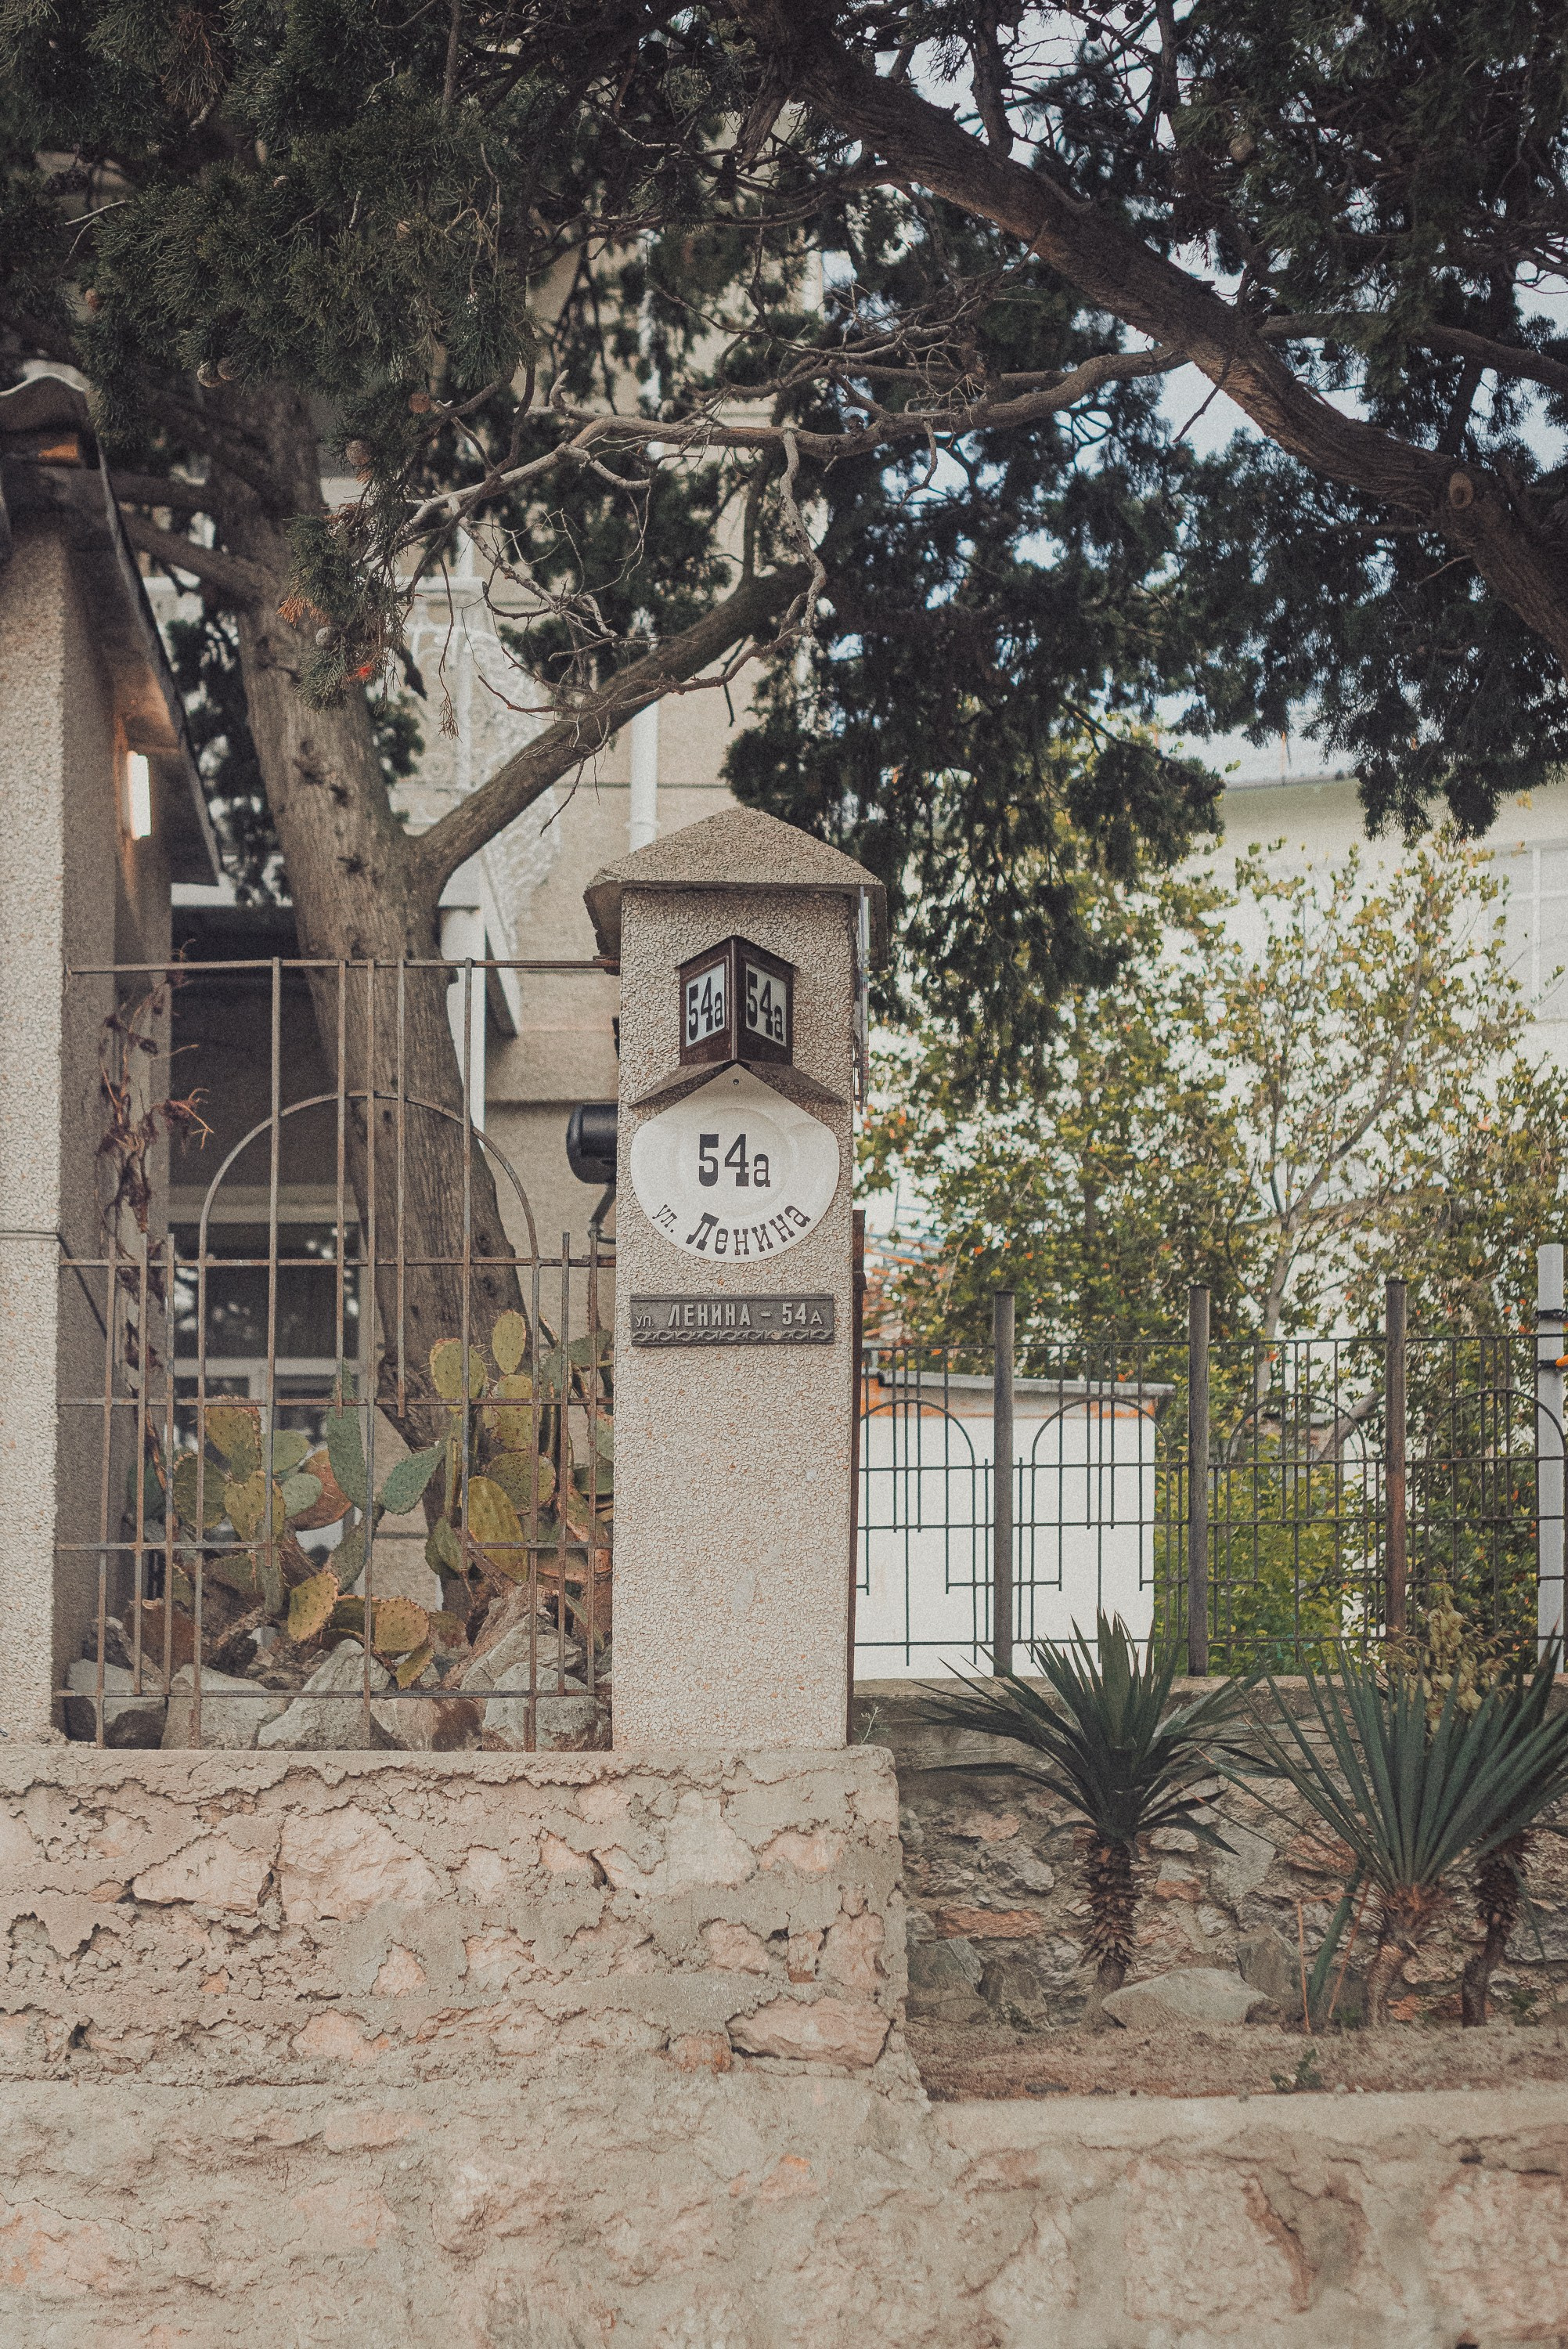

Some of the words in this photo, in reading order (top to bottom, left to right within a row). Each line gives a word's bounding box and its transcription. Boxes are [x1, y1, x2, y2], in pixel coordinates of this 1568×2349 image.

[688, 976, 723, 1041] 54а
[747, 969, 784, 1042] 54а
[698, 1133, 771, 1188] 54а
[651, 1203, 678, 1233] ул.
[685, 1205, 812, 1256] Ленина
[668, 1303, 752, 1327] ЛЕНИНА
